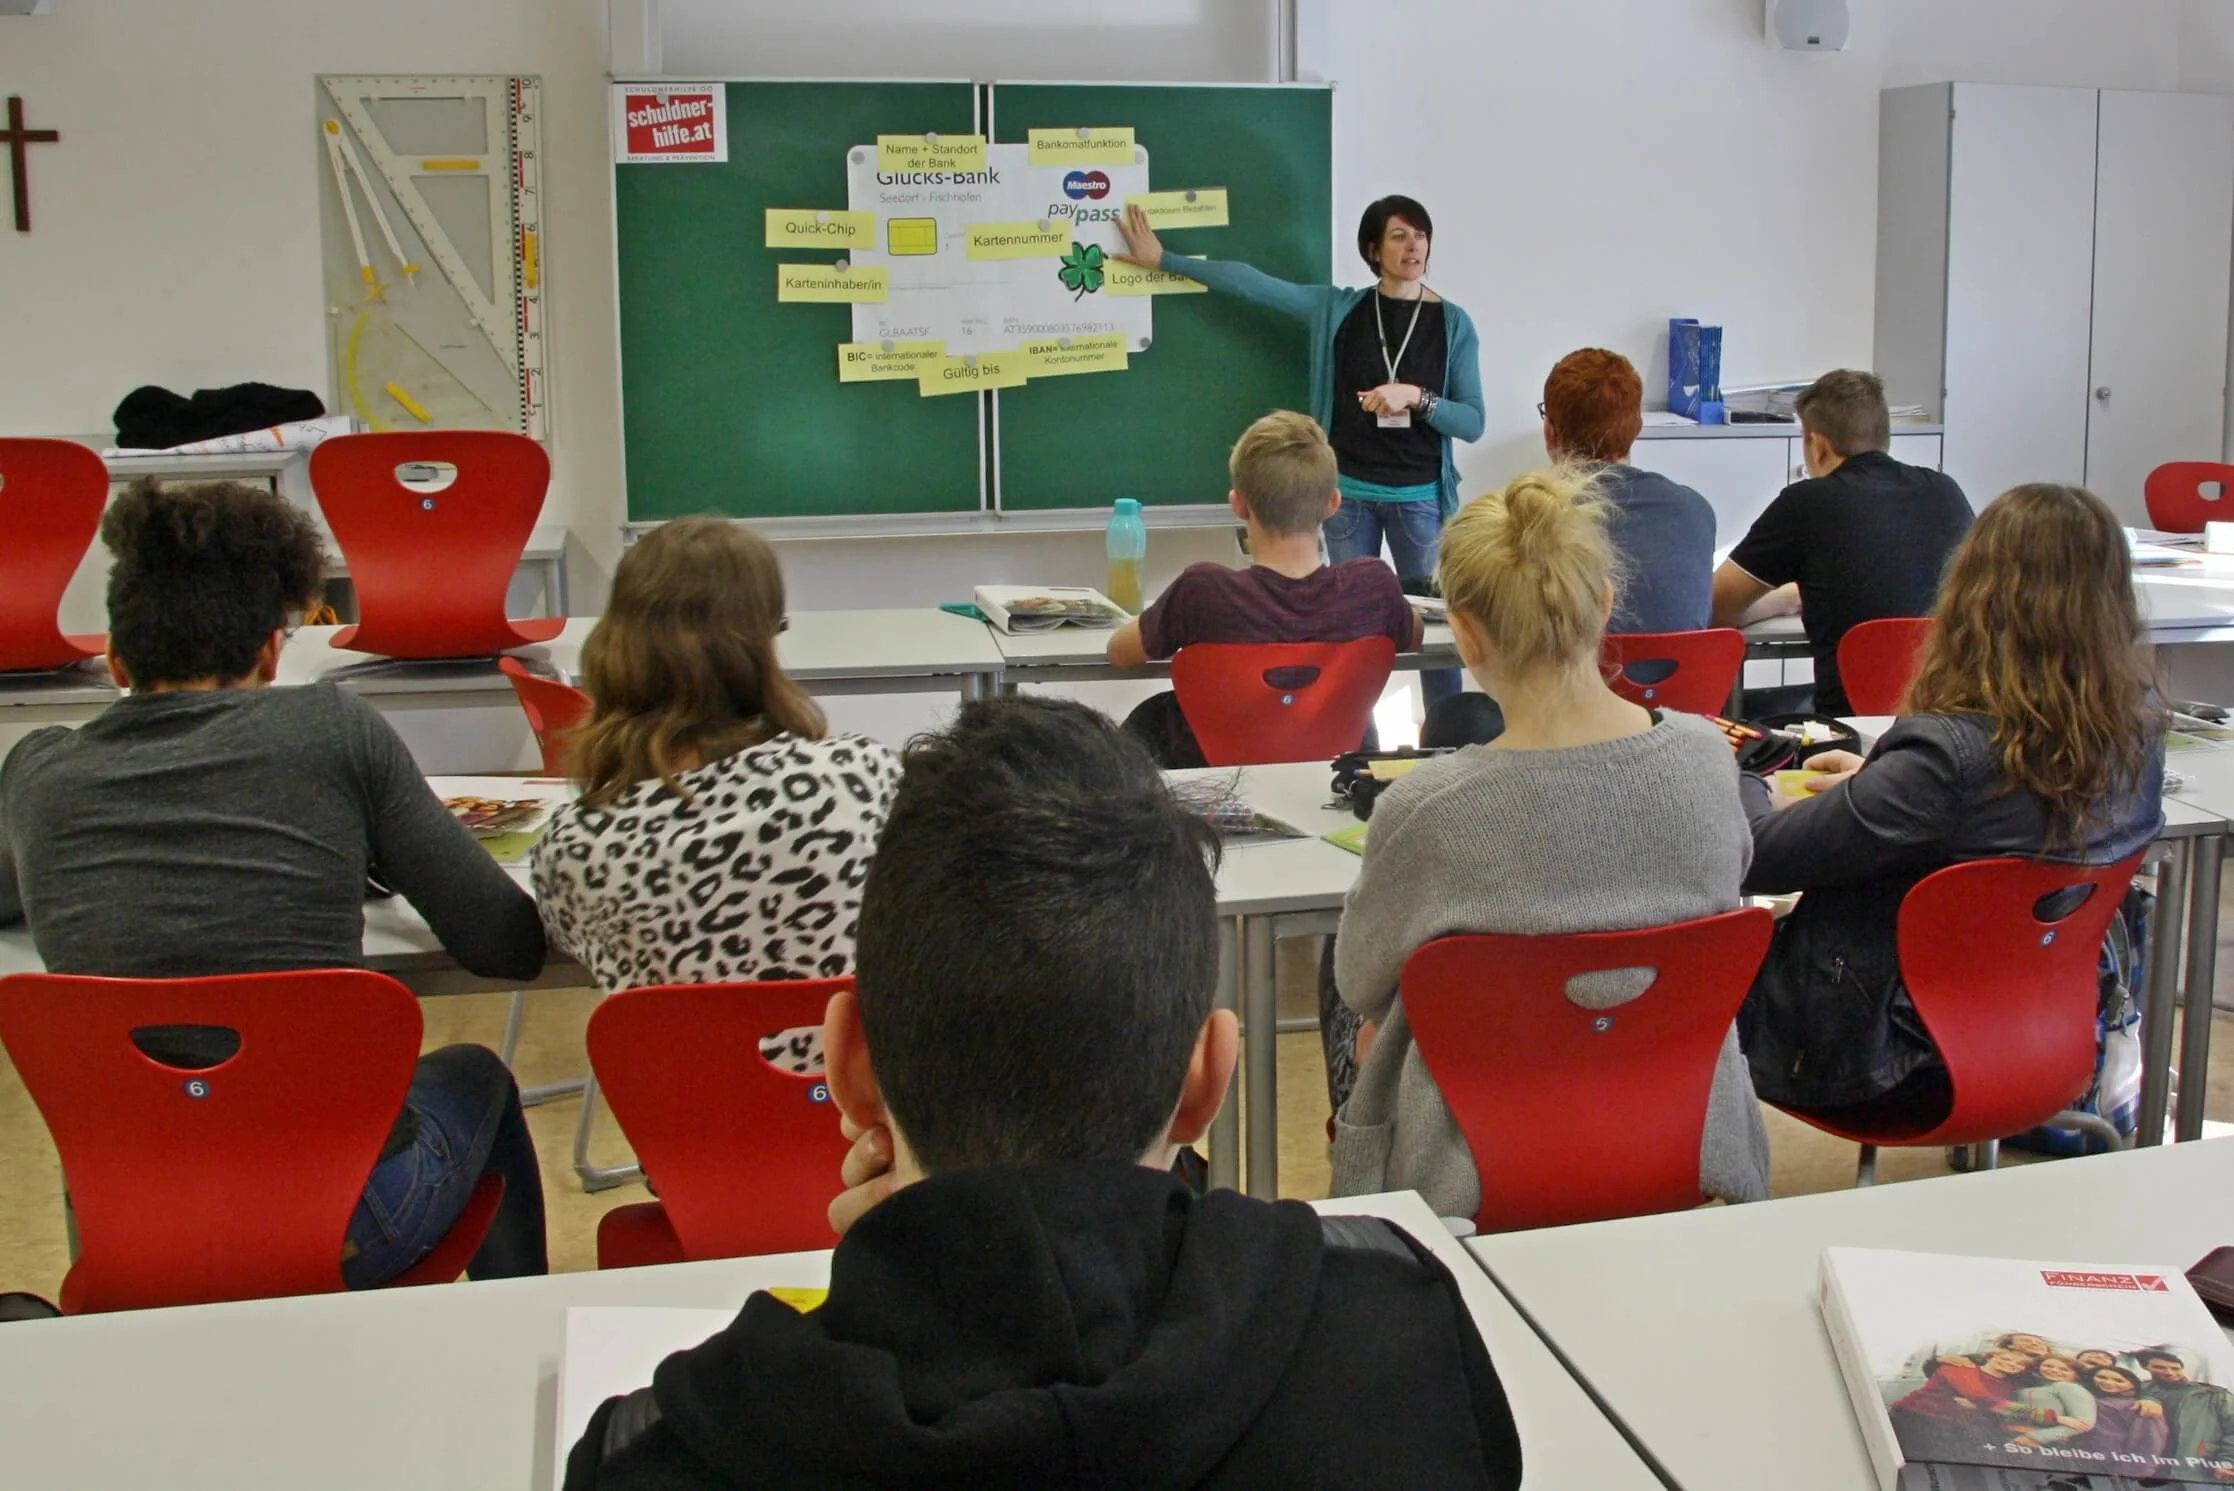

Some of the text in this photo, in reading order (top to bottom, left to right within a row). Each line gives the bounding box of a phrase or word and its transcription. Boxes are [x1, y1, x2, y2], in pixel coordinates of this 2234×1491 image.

[628, 99, 713, 128] schuldner-
[652, 122, 713, 148] hilfe.at
[886, 144, 918, 154] Name
[932, 143, 978, 154] Standort
[1036, 139, 1127, 150] Bankomatfunktion
[908, 158, 957, 168] der Bank
[1066, 181, 1107, 191] Maestro
[785, 221, 856, 237] Quick-Chip
[973, 232, 1064, 247] Kartennummer
[785, 278, 882, 290] Karteninhaber/in
[1111, 273, 1142, 287] Logo
[1145, 272, 1165, 282] der
[875, 350, 938, 361] internationaler
[1044, 352, 1105, 365] Kontonummer
[871, 363, 916, 373] Bankcode
[943, 363, 1001, 380] Gültig bis
[423, 499, 433, 510] 6
[190, 1081, 205, 1096] 6
[813, 1086, 827, 1101] 6
[2044, 1270, 2134, 1285] FINANZ
[1983, 1442, 1997, 1451] +
[2039, 1445, 2105, 1461] bleibe
[2185, 1456, 2234, 1471] Plus
